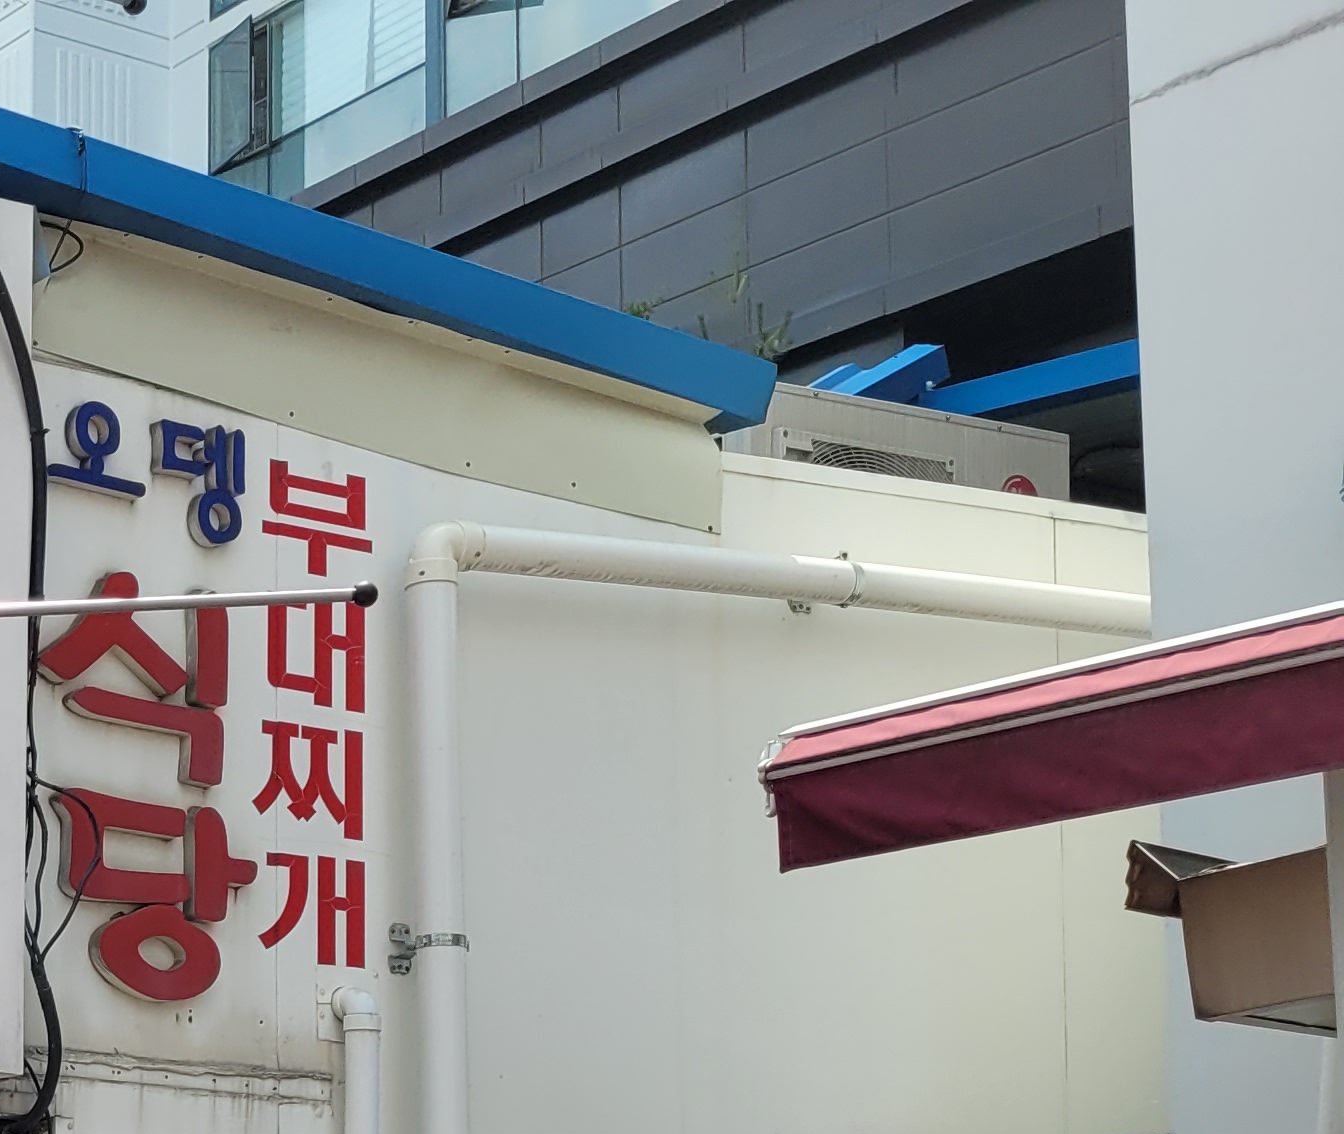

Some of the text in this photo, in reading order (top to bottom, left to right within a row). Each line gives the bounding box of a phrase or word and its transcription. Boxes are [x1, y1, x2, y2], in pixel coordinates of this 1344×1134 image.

[47, 400, 246, 549] 오뎅
[37, 571, 258, 1002] 식당
[251, 458, 373, 968] 부대찌개
